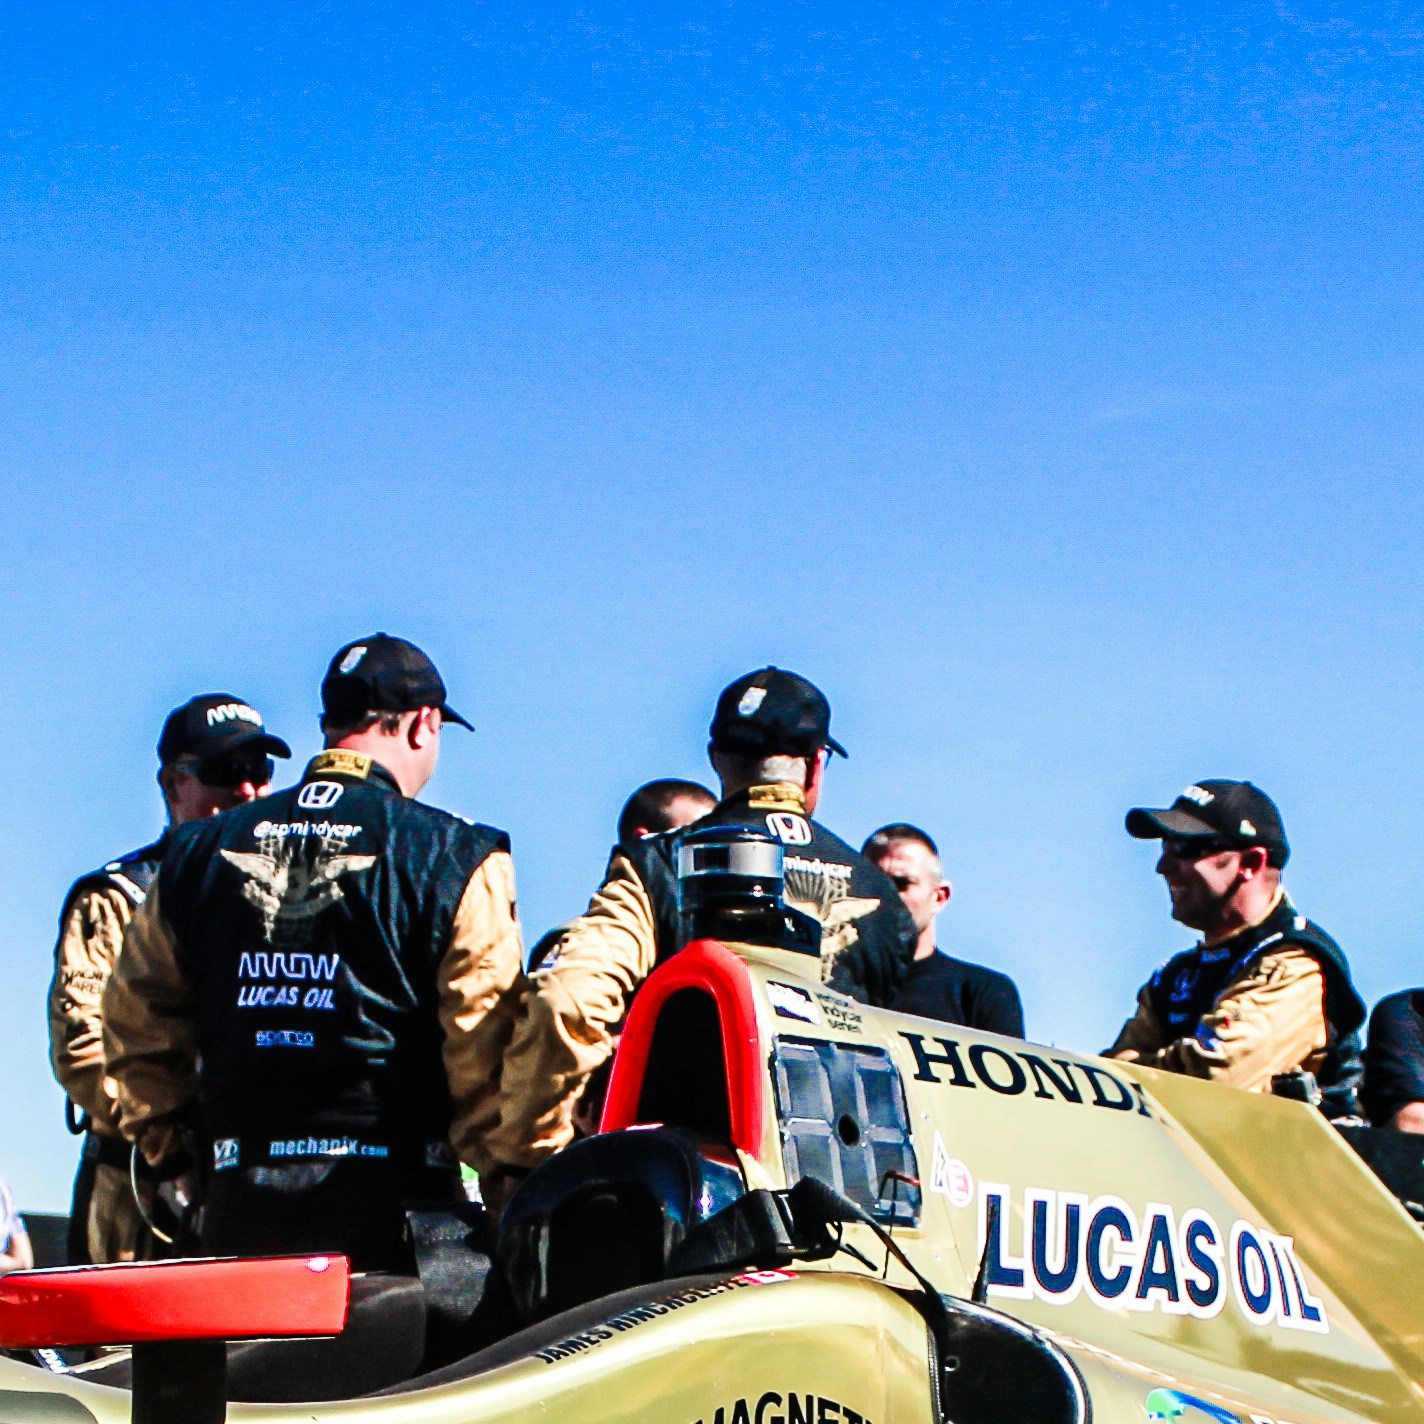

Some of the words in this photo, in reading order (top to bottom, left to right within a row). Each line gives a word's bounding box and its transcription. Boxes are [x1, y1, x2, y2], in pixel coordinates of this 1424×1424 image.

[783, 856, 853, 879] mindycar
[238, 952, 340, 980] ARROW
[237, 985, 299, 1008] LUCAS
[303, 987, 337, 1010] OIL
[984, 1188, 1222, 1309] LUCAS
[1234, 1223, 1326, 1327] OIL
